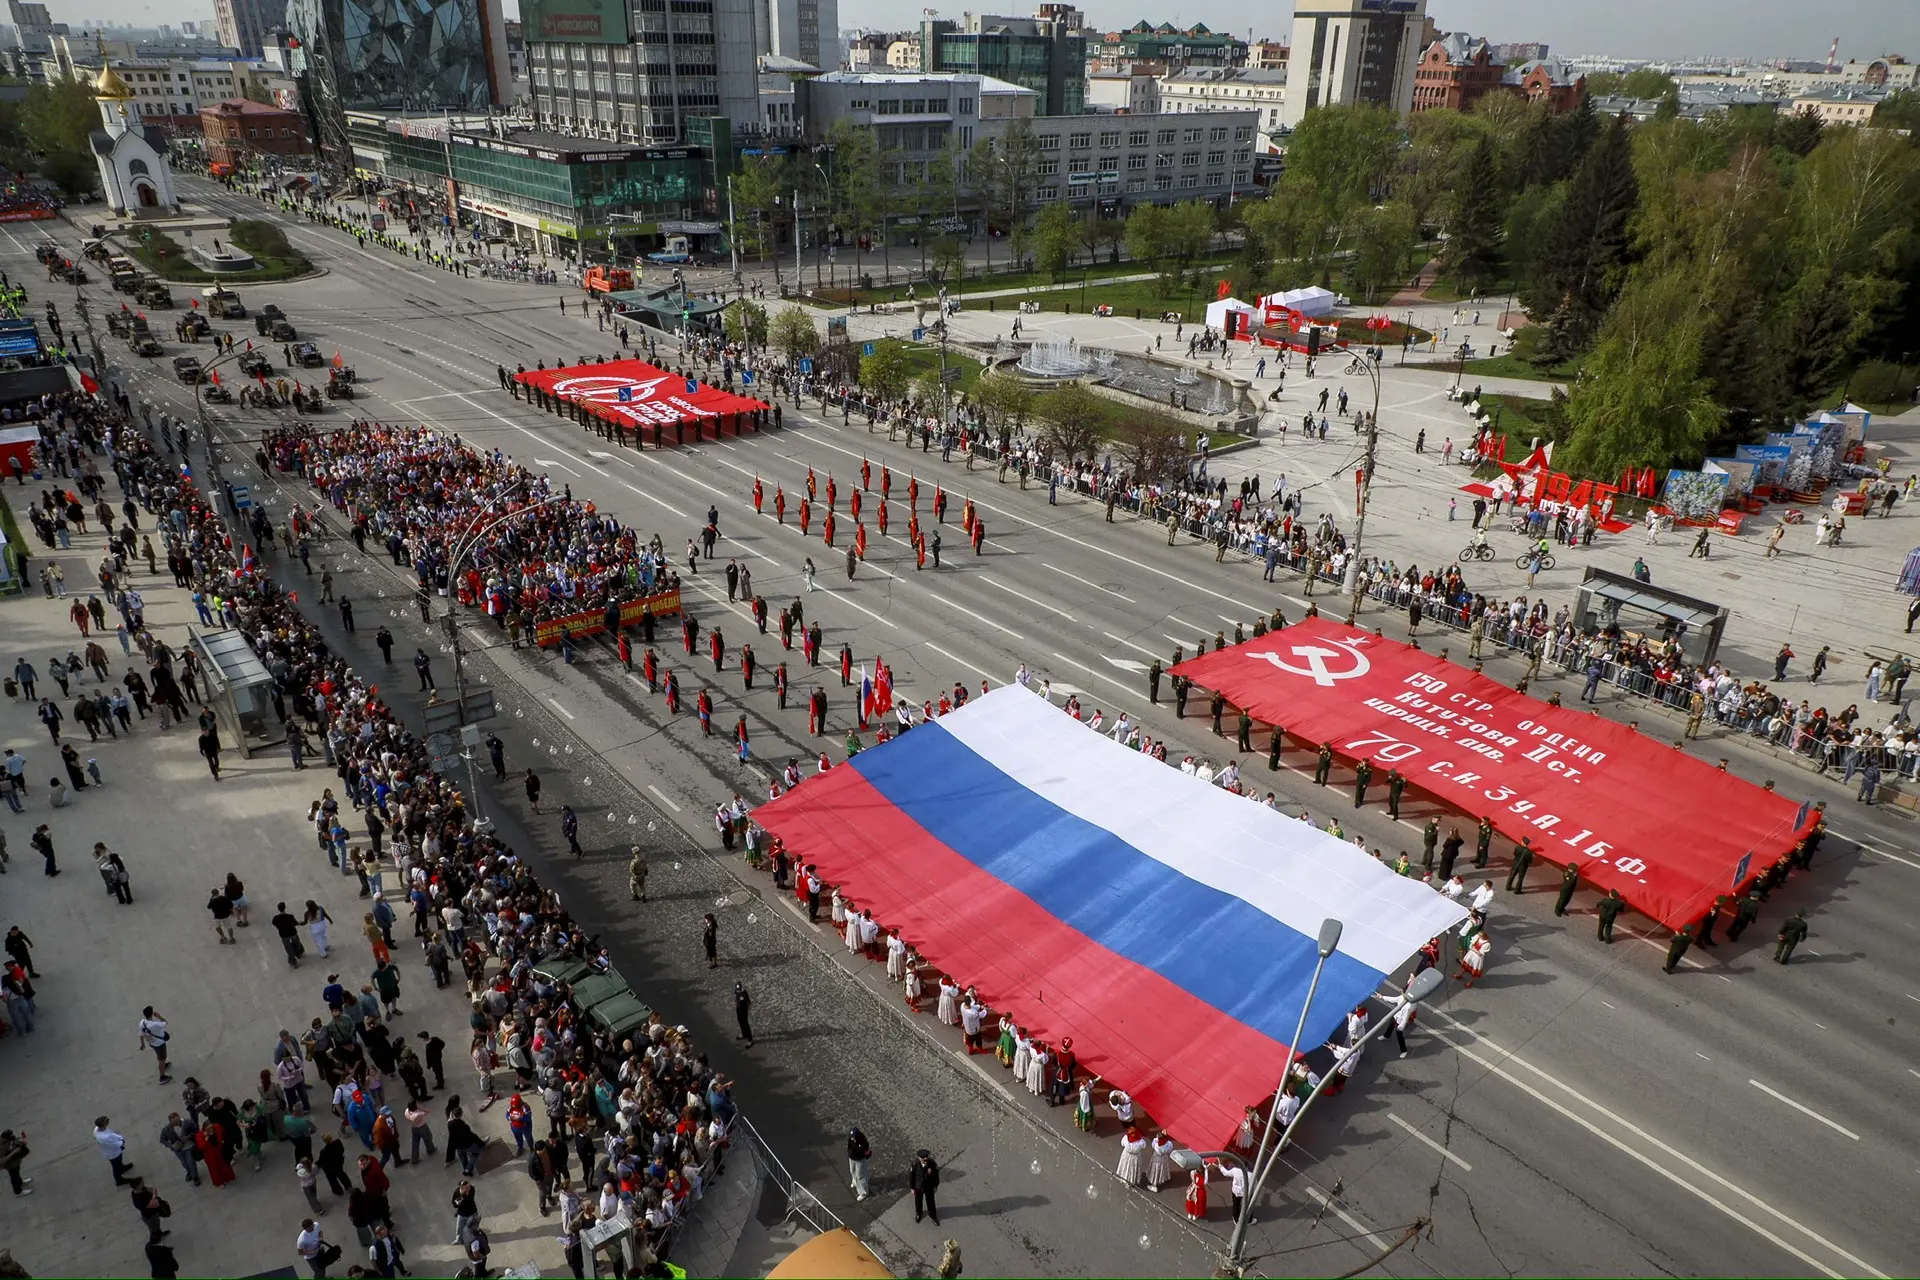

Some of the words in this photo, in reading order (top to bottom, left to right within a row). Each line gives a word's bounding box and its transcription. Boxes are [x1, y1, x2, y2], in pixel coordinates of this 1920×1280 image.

[1533, 471, 1619, 521] 1945
[1539, 499, 1584, 521] ПОБДА
[1403, 672, 1448, 694] 150
[1516, 720, 1607, 765] ОРДЕНА
[1344, 730, 1423, 763] 79
